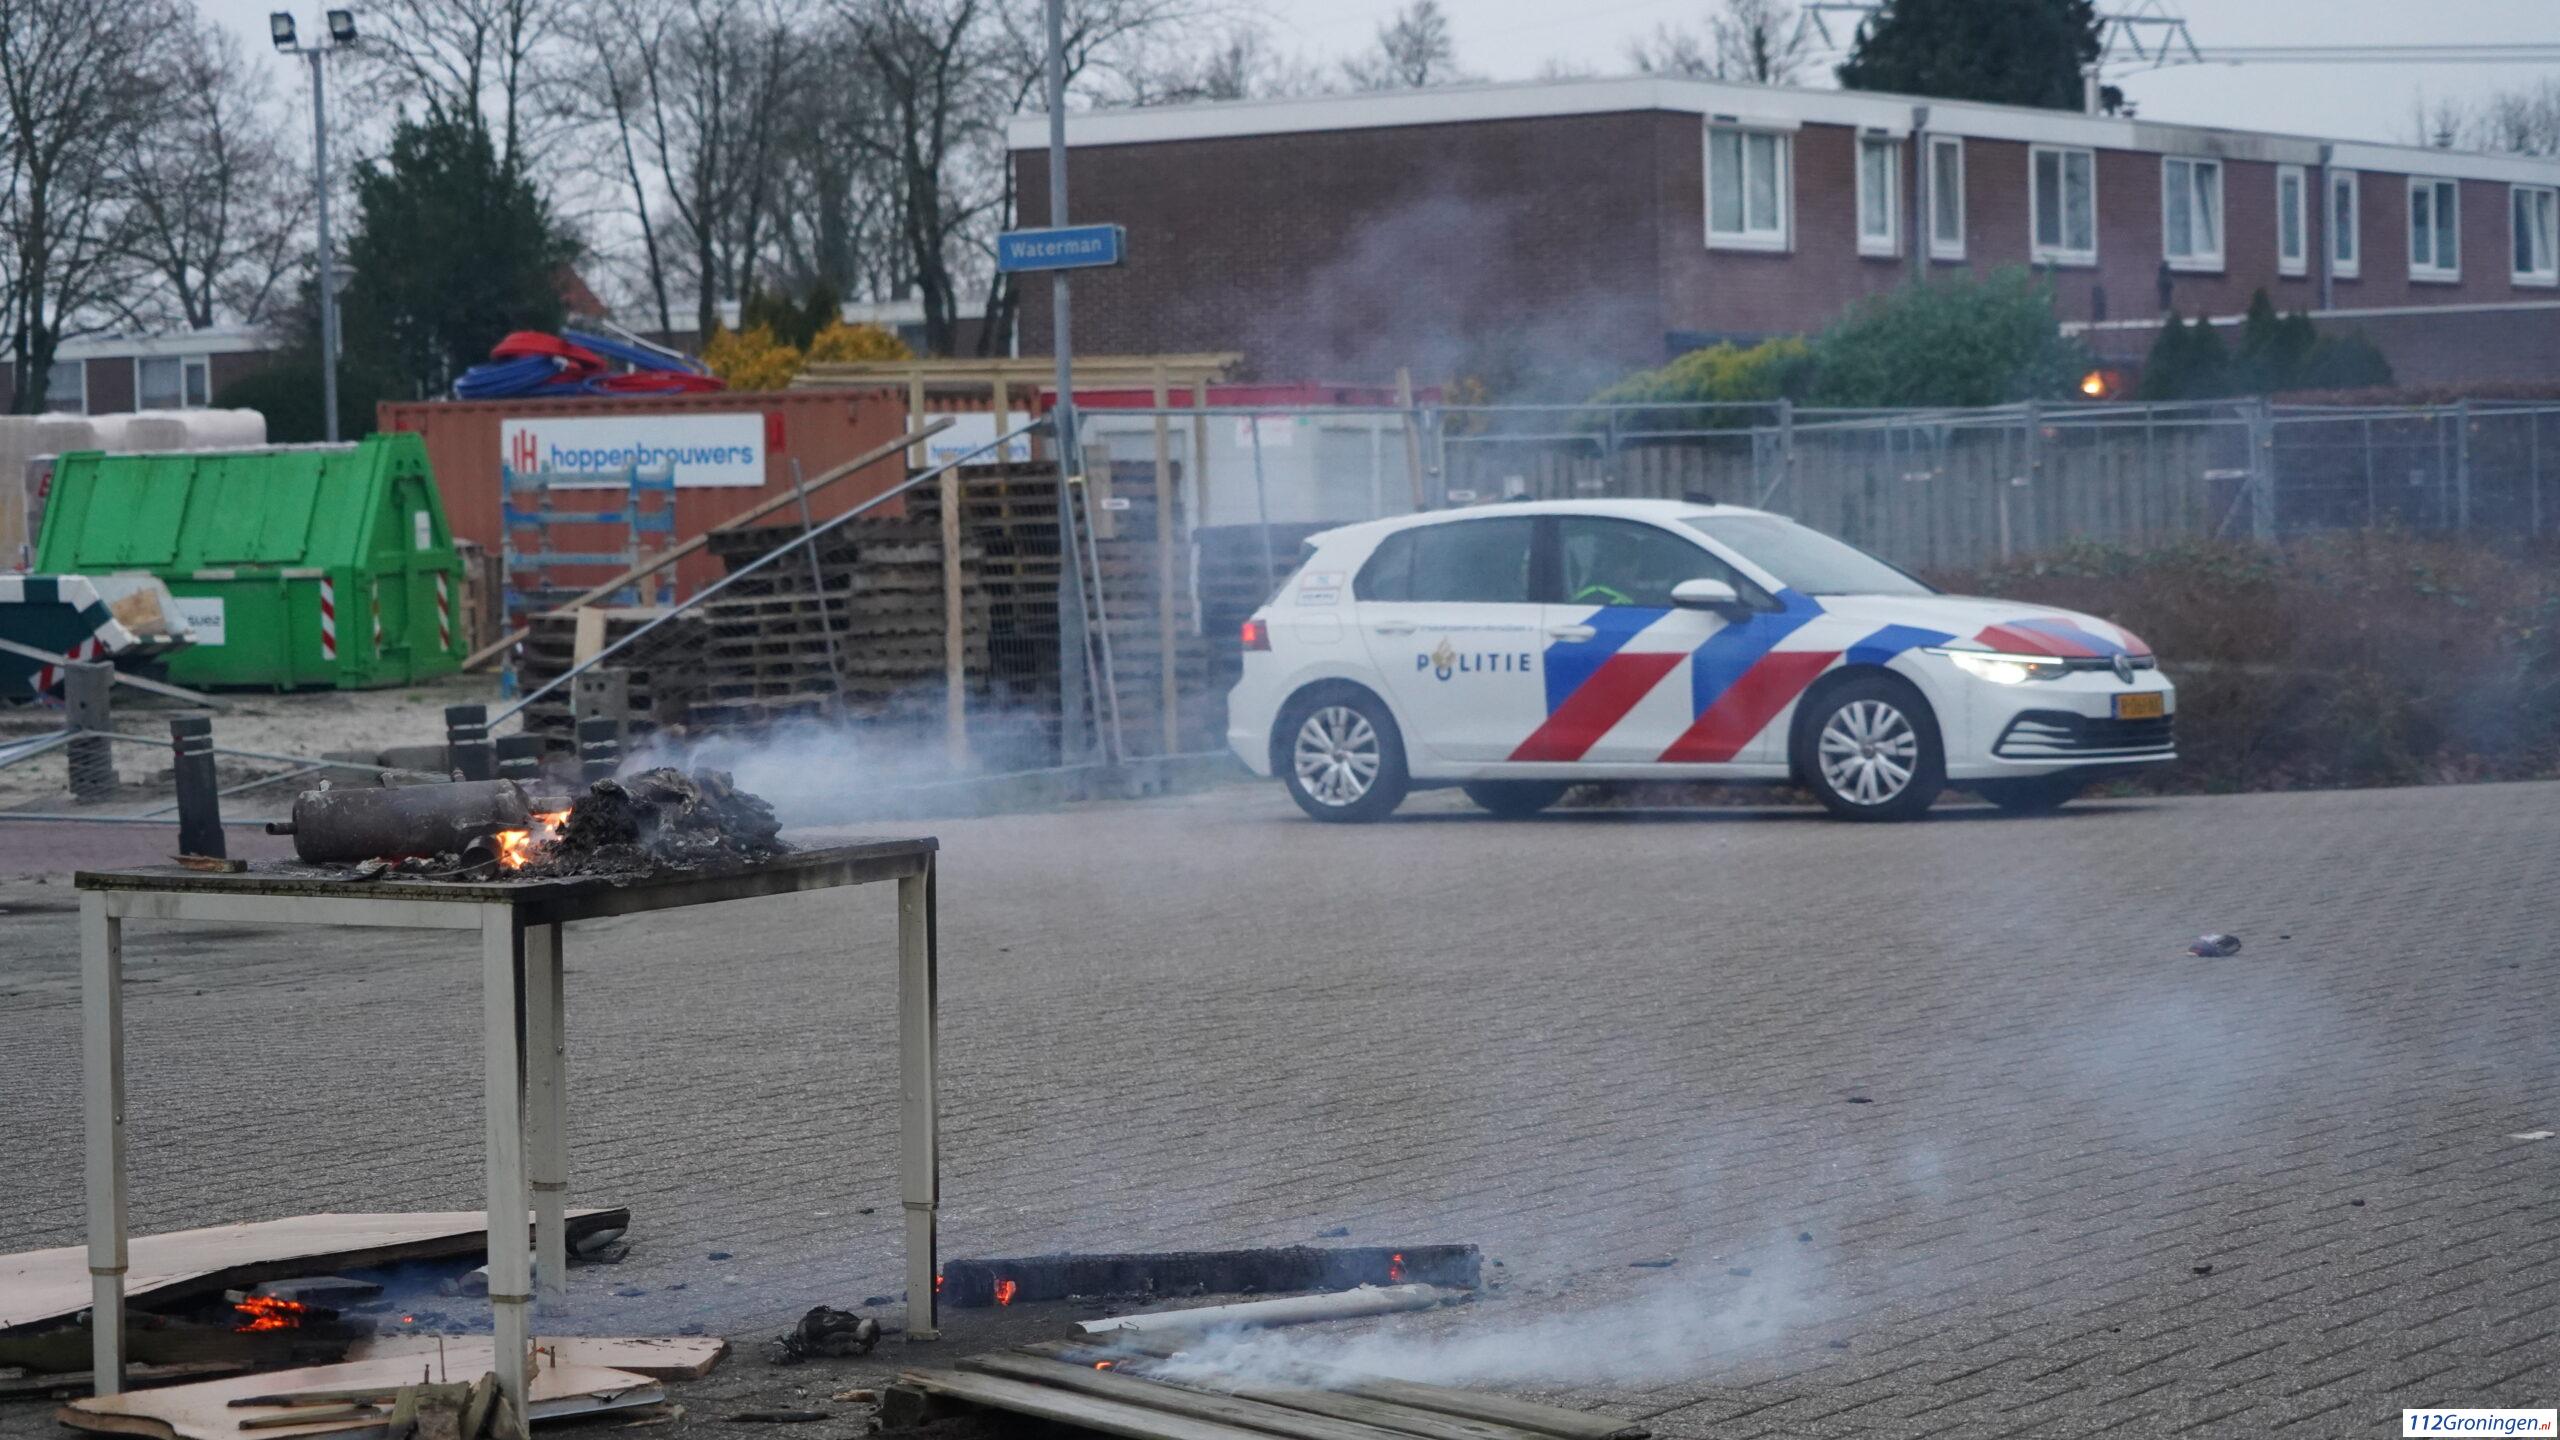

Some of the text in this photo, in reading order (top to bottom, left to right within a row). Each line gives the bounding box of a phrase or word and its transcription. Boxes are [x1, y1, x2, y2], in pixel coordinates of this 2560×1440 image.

[1010, 239, 1102, 258] Waterman
[551, 442, 754, 469] hoppenbrouwers
[1416, 652, 1531, 681] POLITIE
